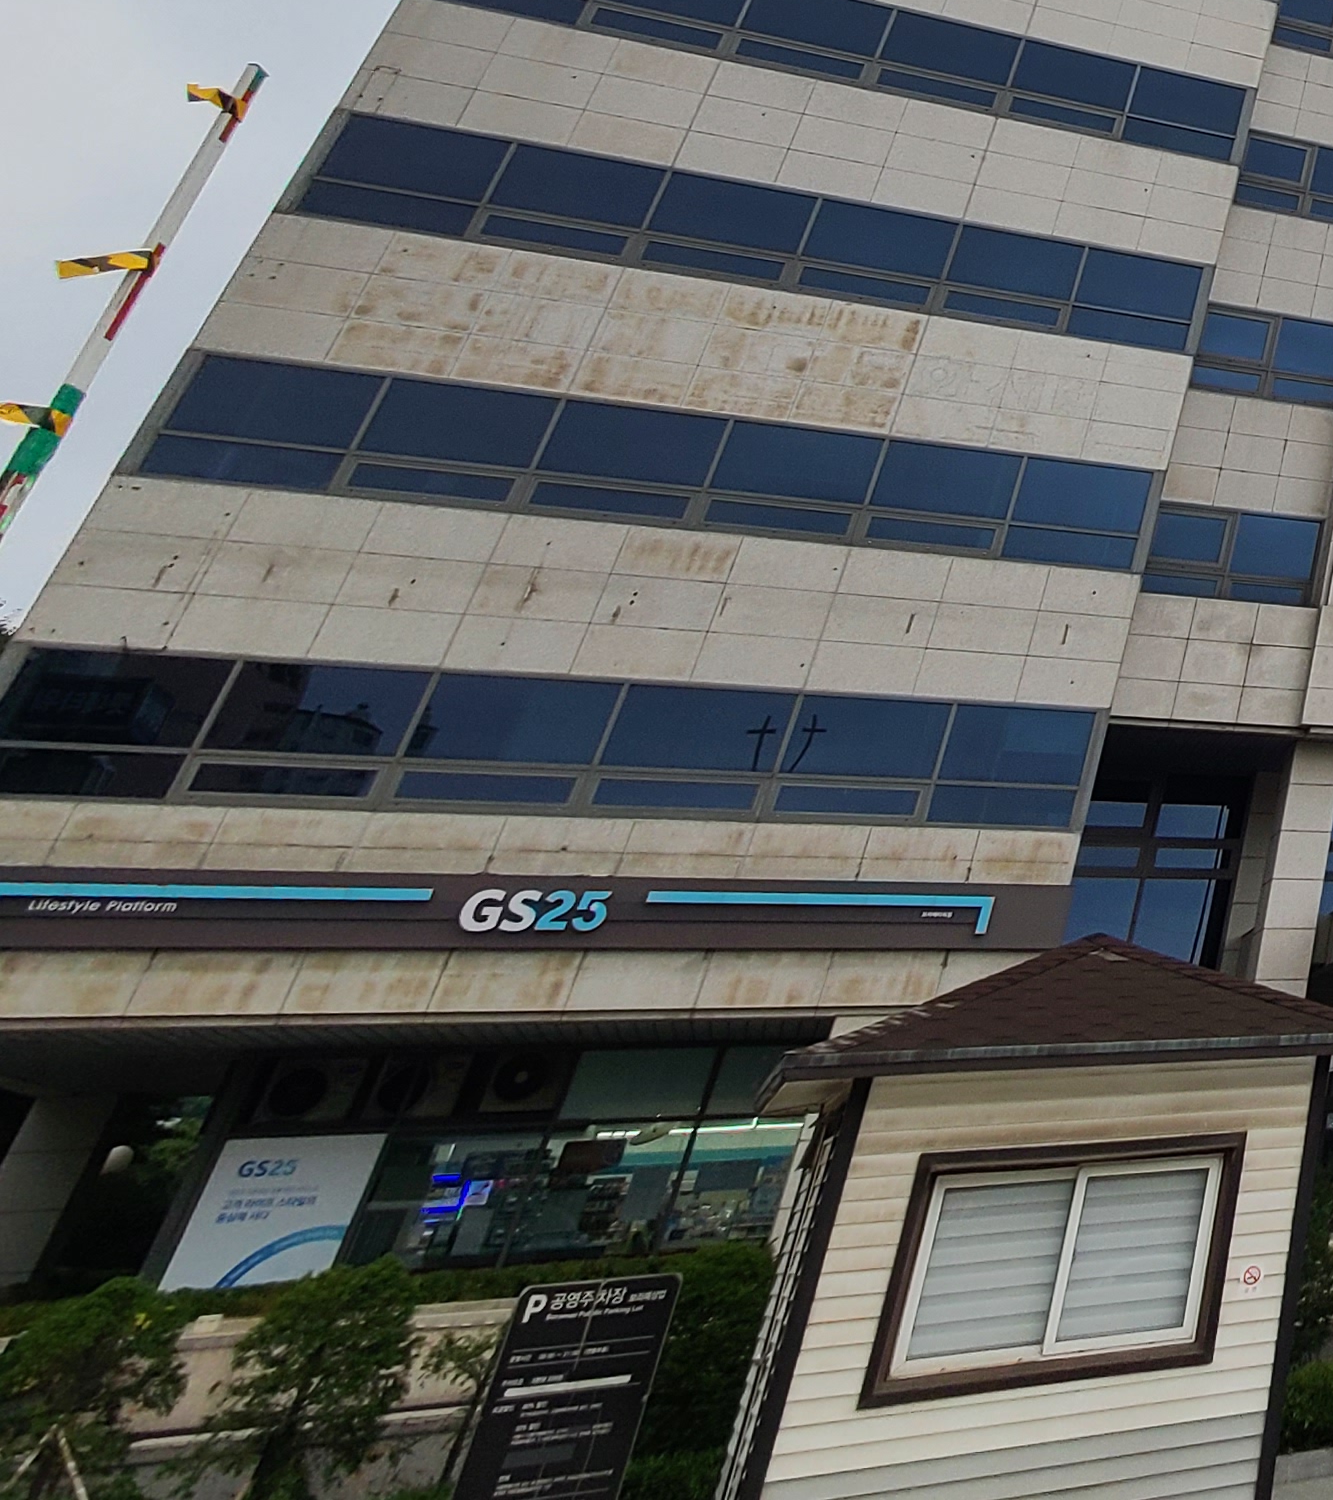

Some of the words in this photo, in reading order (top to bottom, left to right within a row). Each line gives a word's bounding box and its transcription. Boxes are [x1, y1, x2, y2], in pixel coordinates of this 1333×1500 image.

[27, 899, 101, 915] Lifestyle
[104, 900, 178, 913] Platform
[459, 889, 613, 932] GS25
[238, 1159, 300, 1178] GS25
[521, 1293, 548, 1324] P
[550, 1286, 628, 1310] 공영주차장
